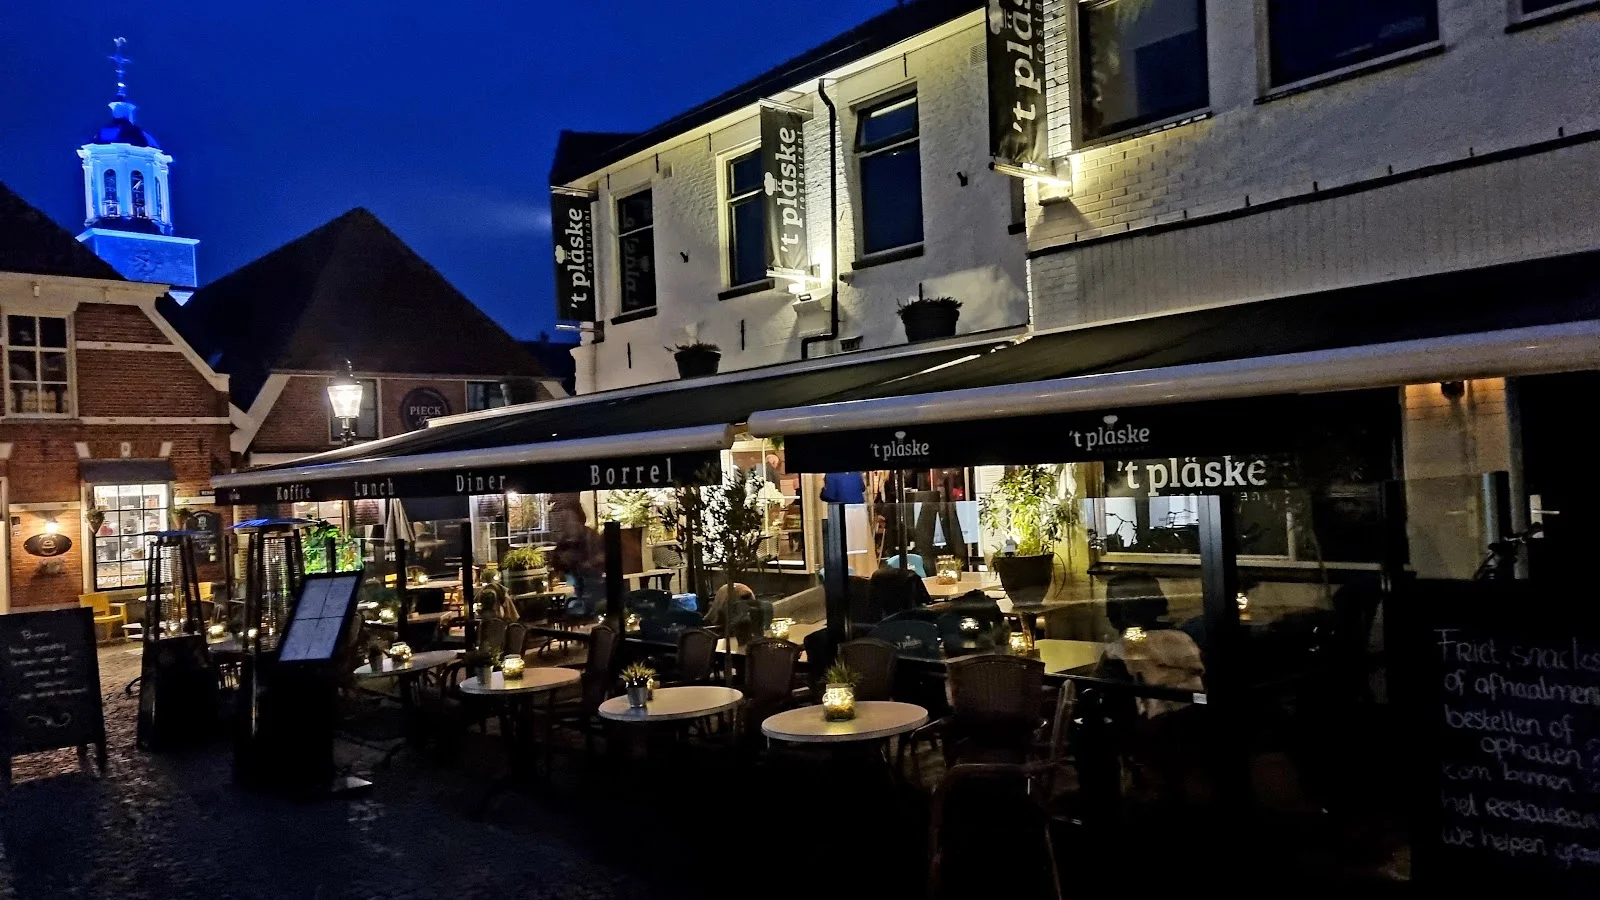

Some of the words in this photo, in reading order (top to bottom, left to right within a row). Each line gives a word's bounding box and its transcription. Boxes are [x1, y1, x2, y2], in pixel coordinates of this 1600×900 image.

[775, 127, 804, 228] pläske
[796, 130, 806, 211] restaurant
[565, 207, 592, 288] pläske
[583, 209, 593, 274] restaurant
[780, 233, 800, 253] 't
[570, 292, 588, 309] 't
[410, 405, 442, 416] PIECK
[1069, 429, 1083, 448] 't
[456, 472, 507, 493] Diner
[589, 457, 674, 486] Borrel
[1116, 460, 1141, 489] 't
[1146, 455, 1268, 497] pläske
[276, 484, 311, 501] Koffie
[353, 478, 395, 497] Lunch
[1443, 669, 1466, 697] of
[1443, 703, 1543, 737] bestellen
[1549, 714, 1574, 746] of
